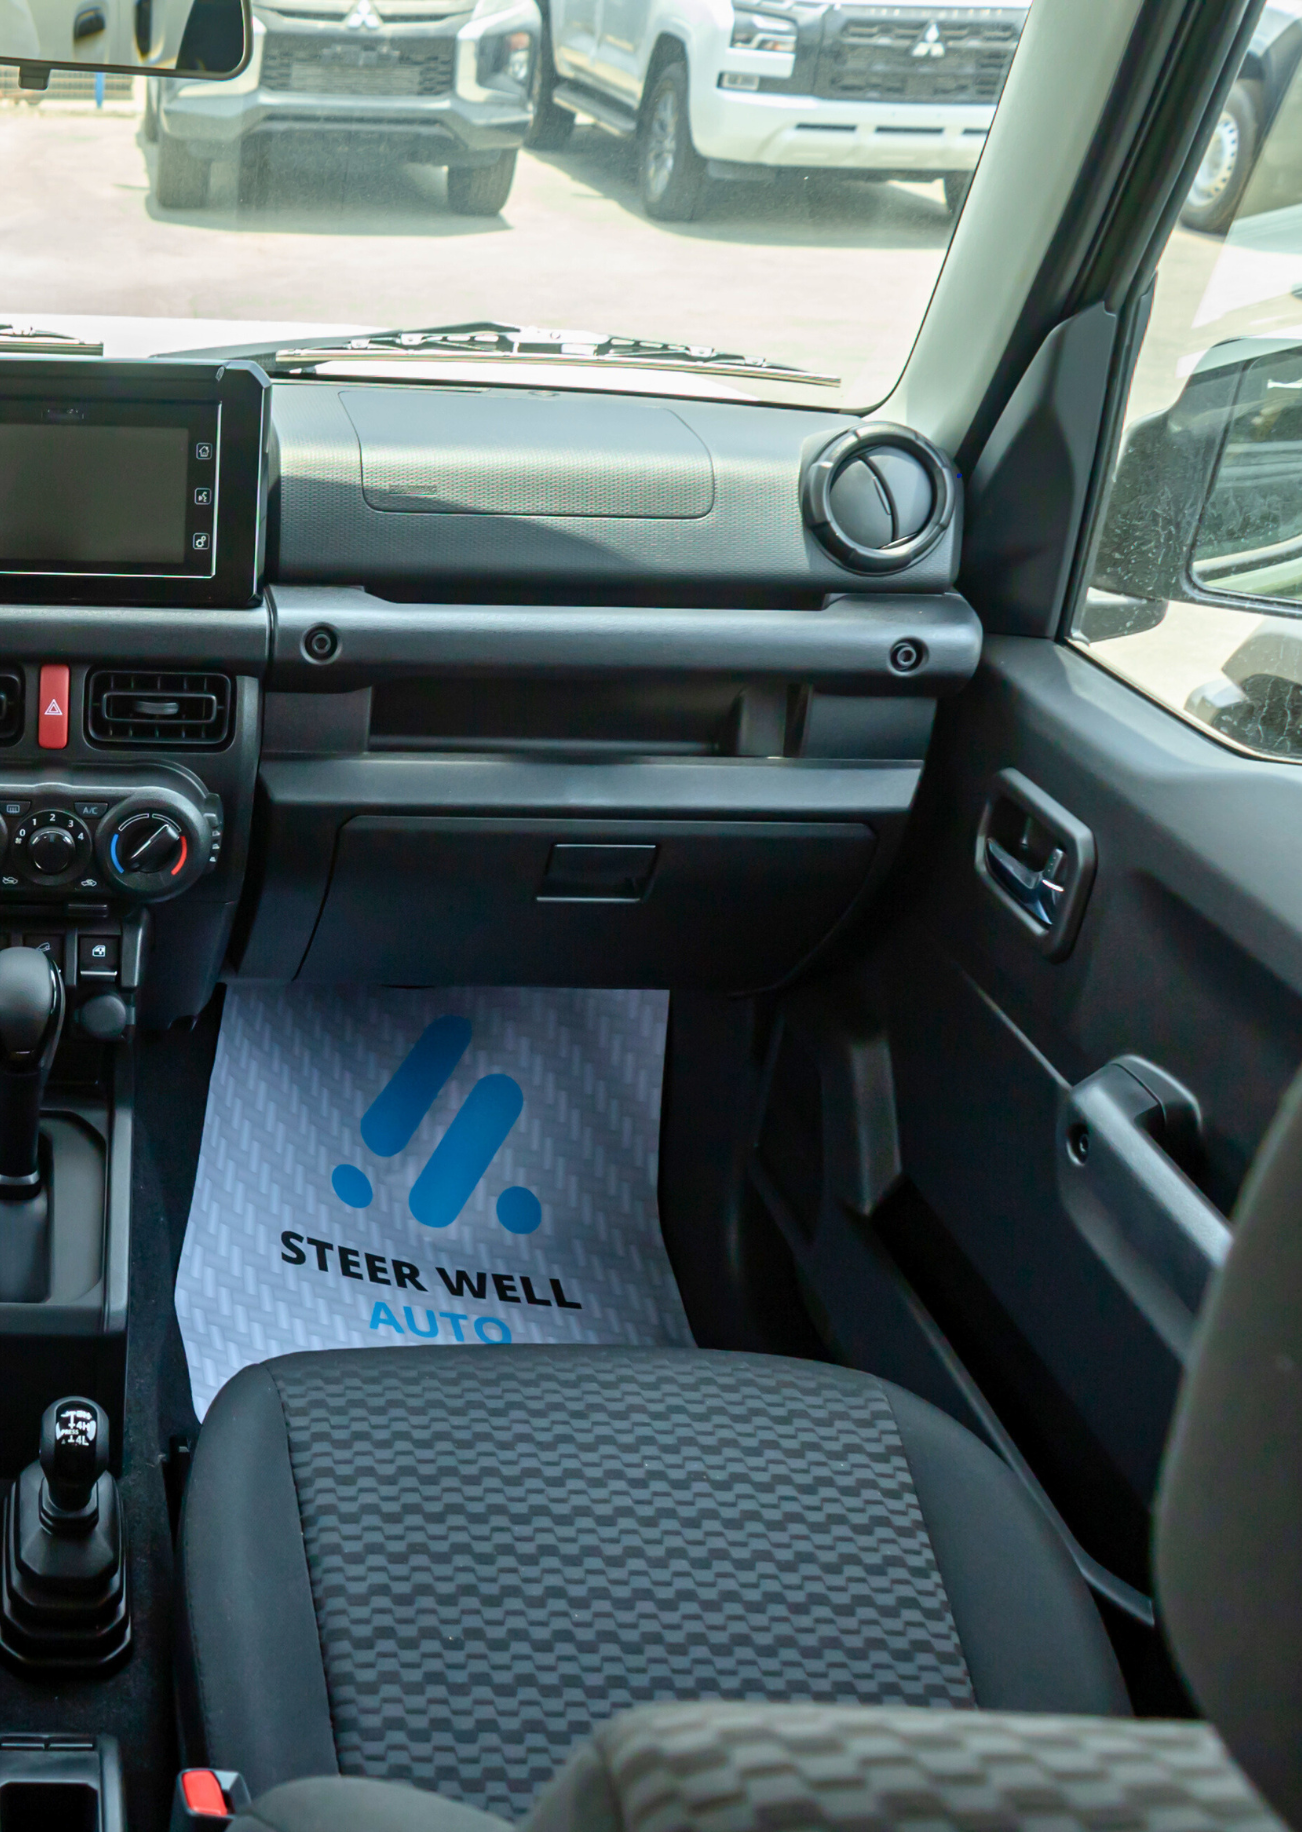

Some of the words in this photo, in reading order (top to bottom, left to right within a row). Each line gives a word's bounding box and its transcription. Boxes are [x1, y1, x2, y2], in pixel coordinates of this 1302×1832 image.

[82, 806, 98, 815] A/C
[49, 813, 56, 821] 2
[32, 818, 37, 826] 1
[68, 820, 74, 828] 3
[77, 832, 84, 840] 4
[280, 1230, 429, 1292] STEER
[435, 1266, 583, 1309] WELL
[369, 1301, 512, 1344] AUTO
[76, 1435, 89, 1446] 4L
